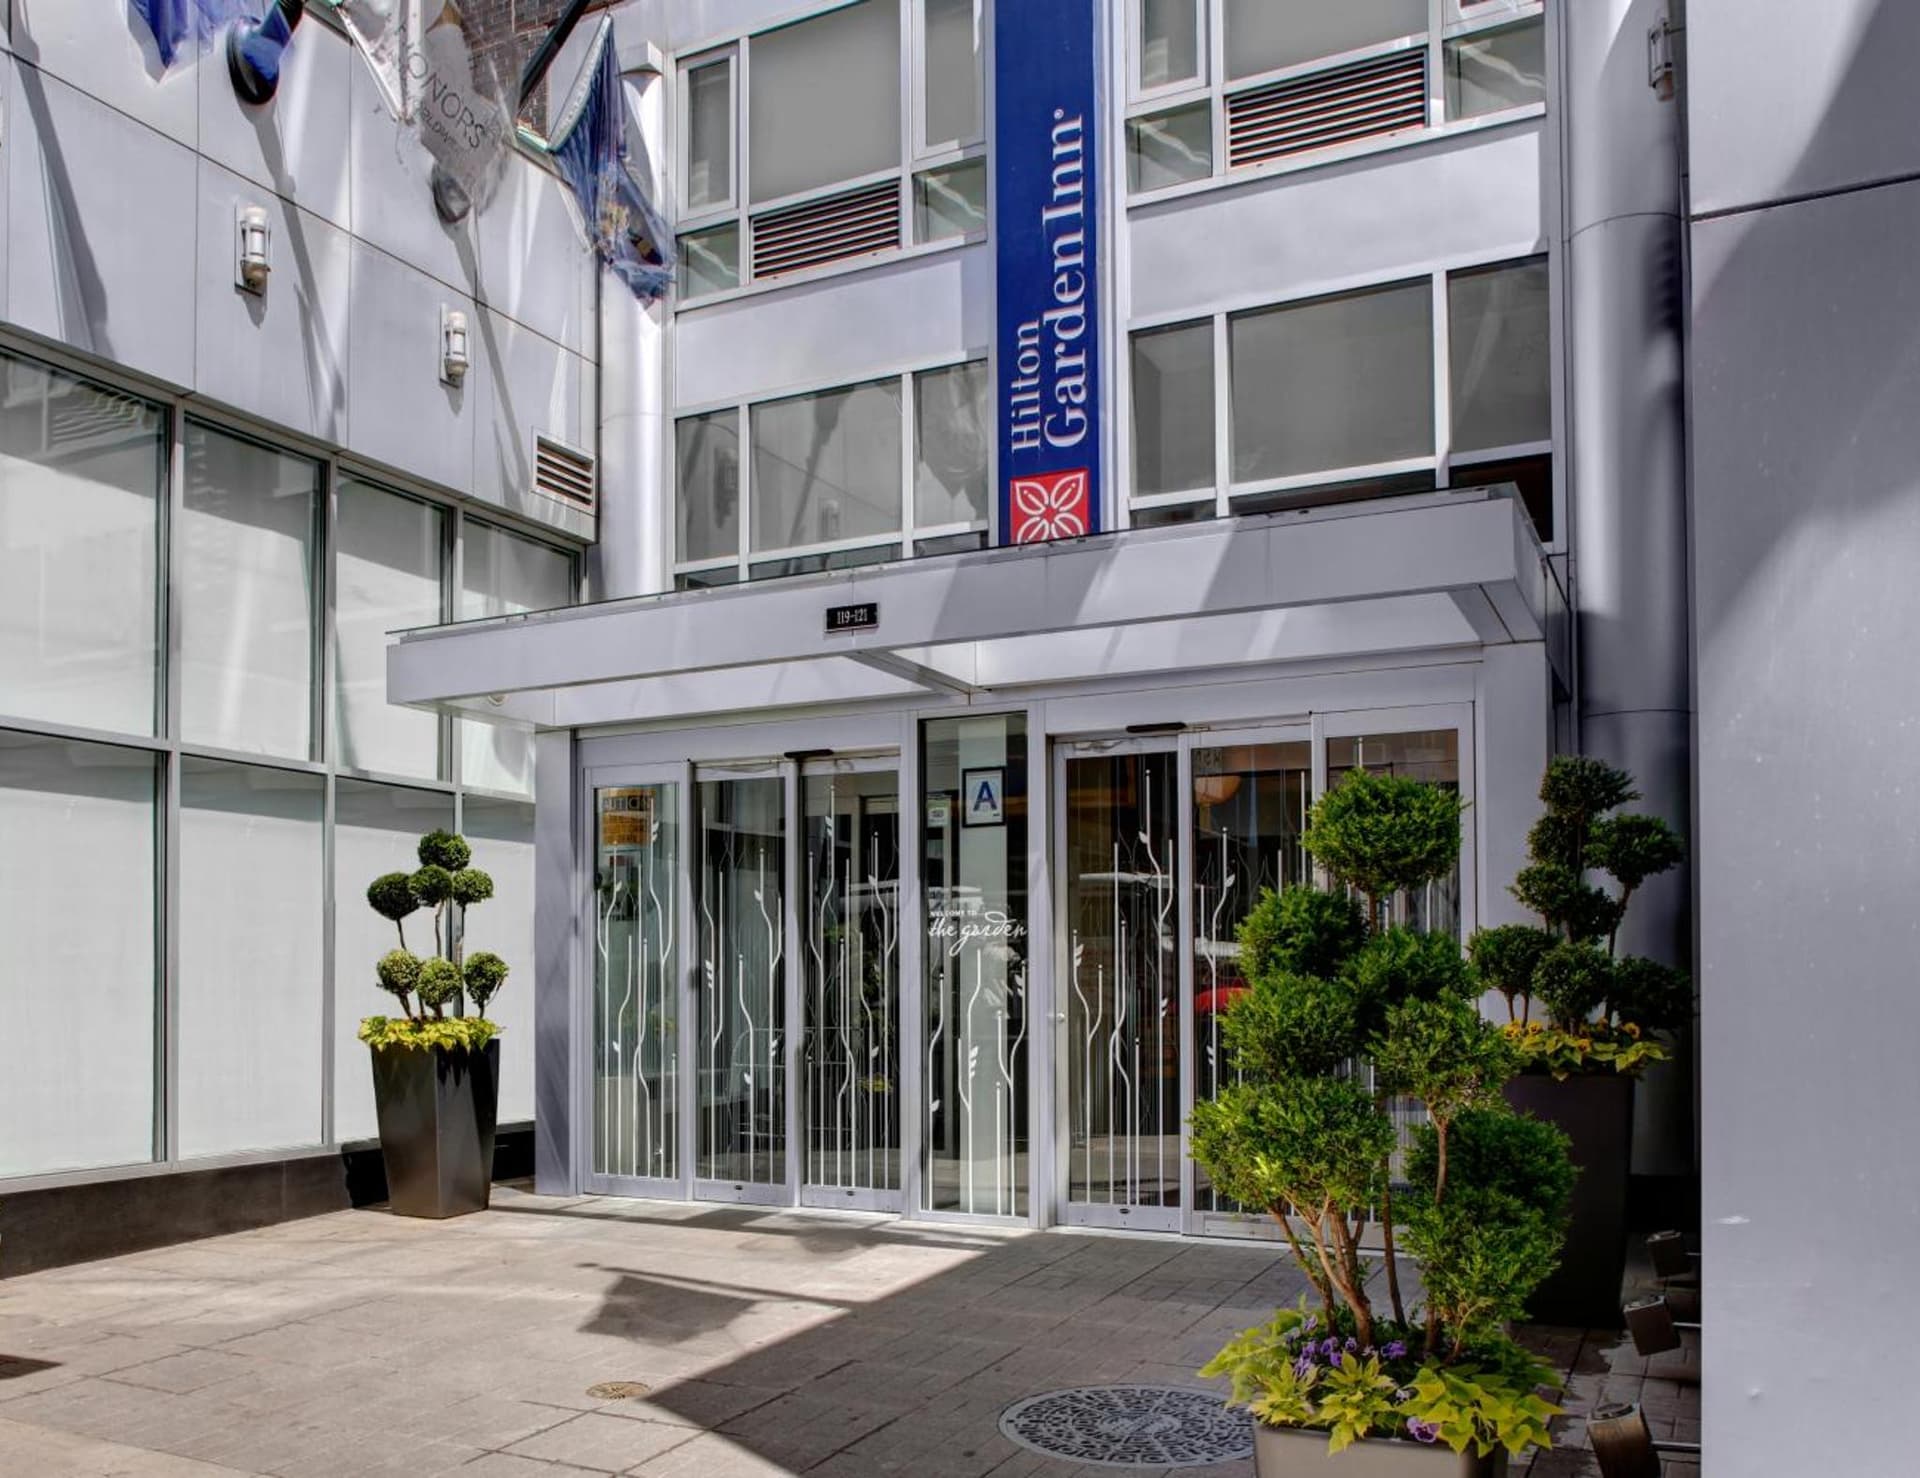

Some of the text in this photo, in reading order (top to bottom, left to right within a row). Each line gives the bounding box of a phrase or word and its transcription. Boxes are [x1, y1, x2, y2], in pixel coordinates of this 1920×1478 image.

[402, 42, 485, 149] ONORS
[1043, 228, 1087, 448] Garden
[1011, 320, 1040, 453] Hilton
[836, 608, 868, 625] 119-121
[972, 780, 998, 812] A
[928, 911, 1028, 957] the garden
